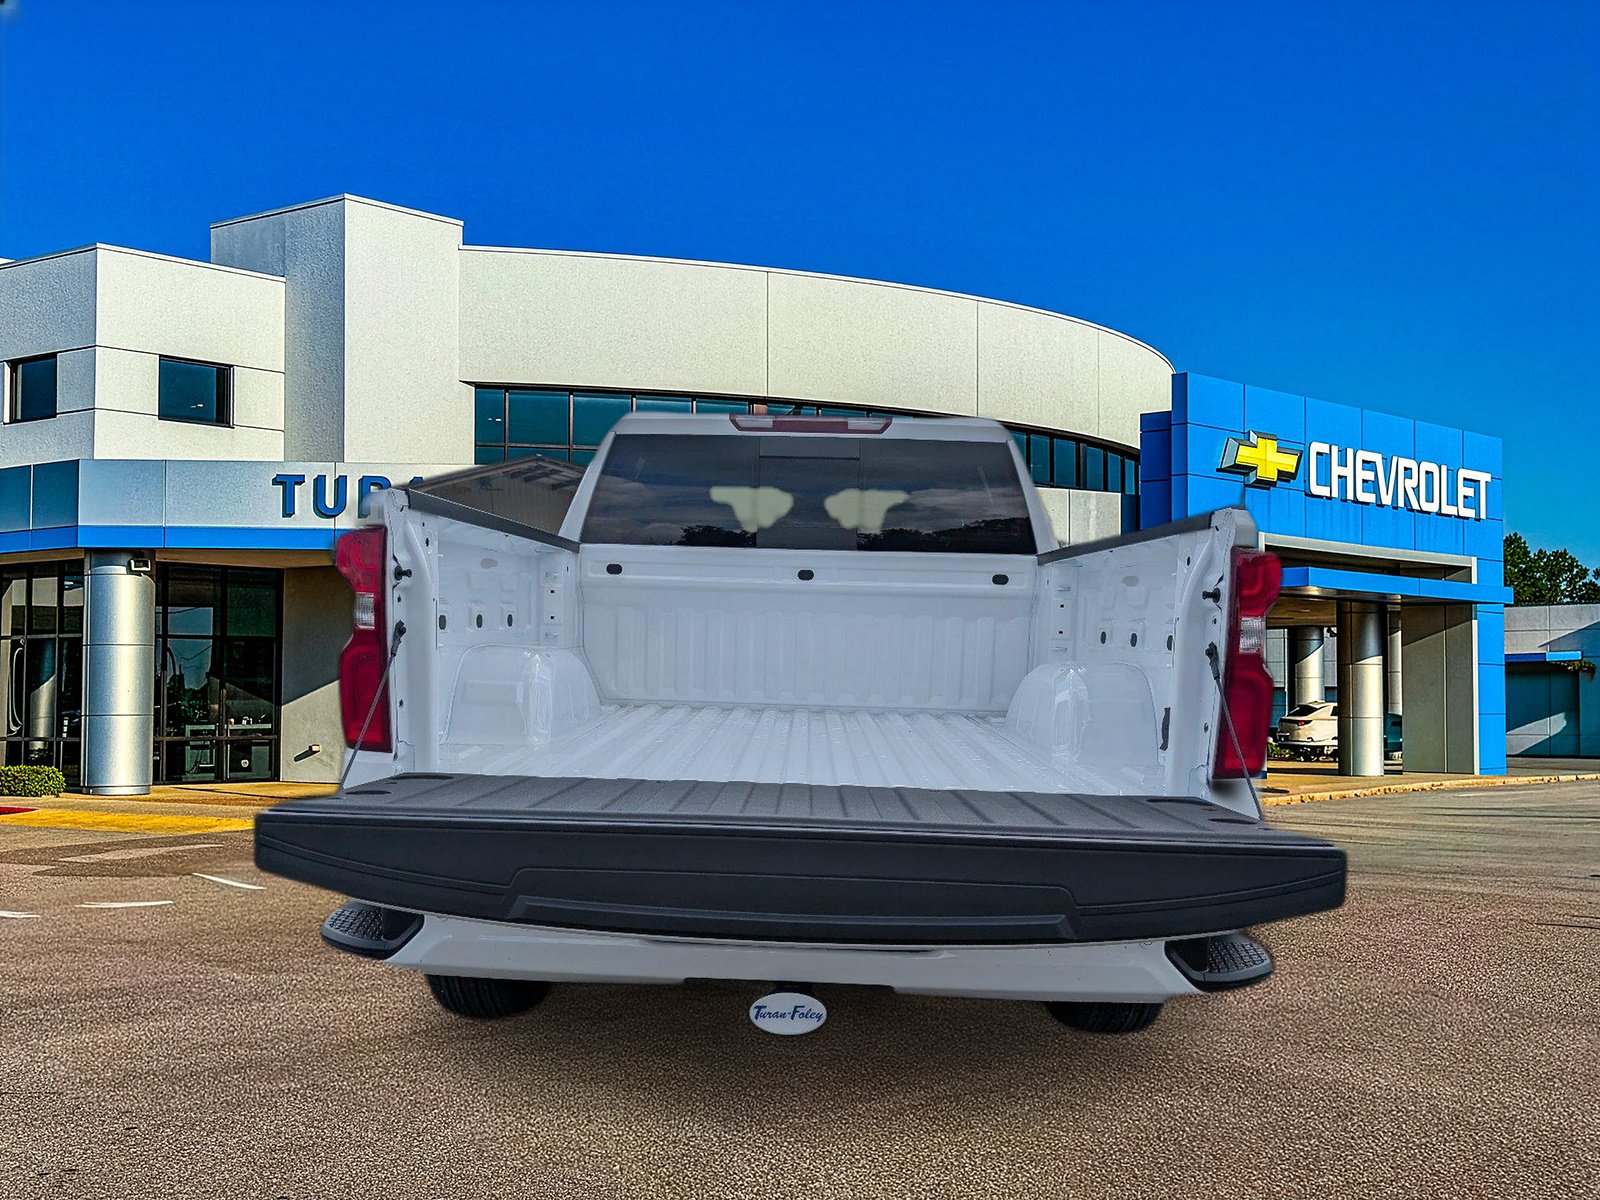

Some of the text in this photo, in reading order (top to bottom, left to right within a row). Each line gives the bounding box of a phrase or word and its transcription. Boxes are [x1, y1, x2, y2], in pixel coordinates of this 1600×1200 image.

[272, 474, 424, 519] TUR
[1308, 441, 1492, 520] CHEVROLET
[753, 1004, 824, 1023] Turan-Foley
